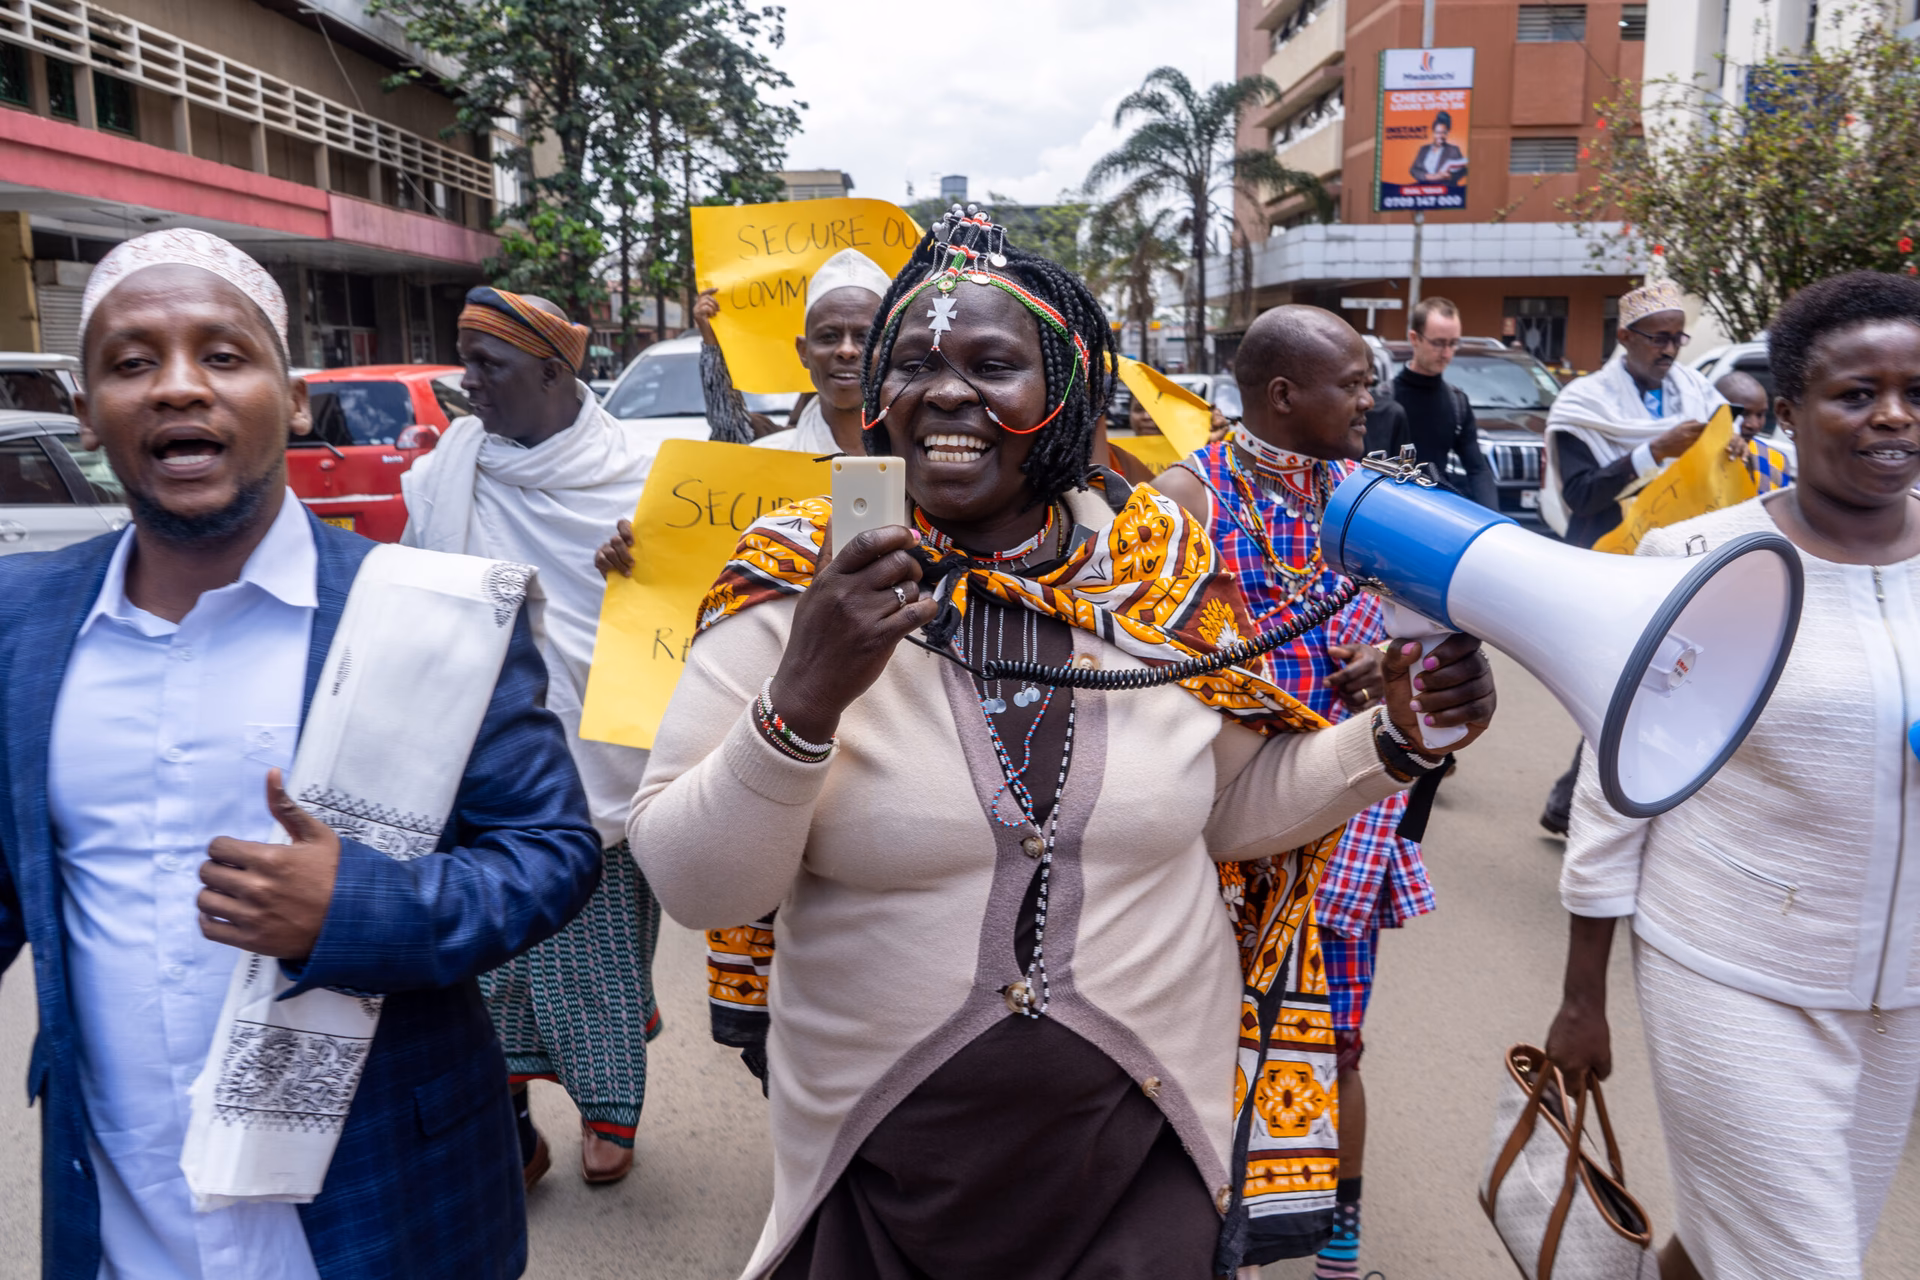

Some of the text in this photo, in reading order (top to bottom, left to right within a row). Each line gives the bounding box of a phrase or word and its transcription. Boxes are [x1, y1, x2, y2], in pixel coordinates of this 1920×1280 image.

[1402, 72, 1455, 81] Mwananchi
[1390, 91, 1466, 103] CHECK-OFF
[1389, 103, 1423, 112] LOANS
[1385, 125, 1428, 133] INSTANT
[1437, 195, 1462, 207] 000
[737, 214, 871, 261] SECURE
